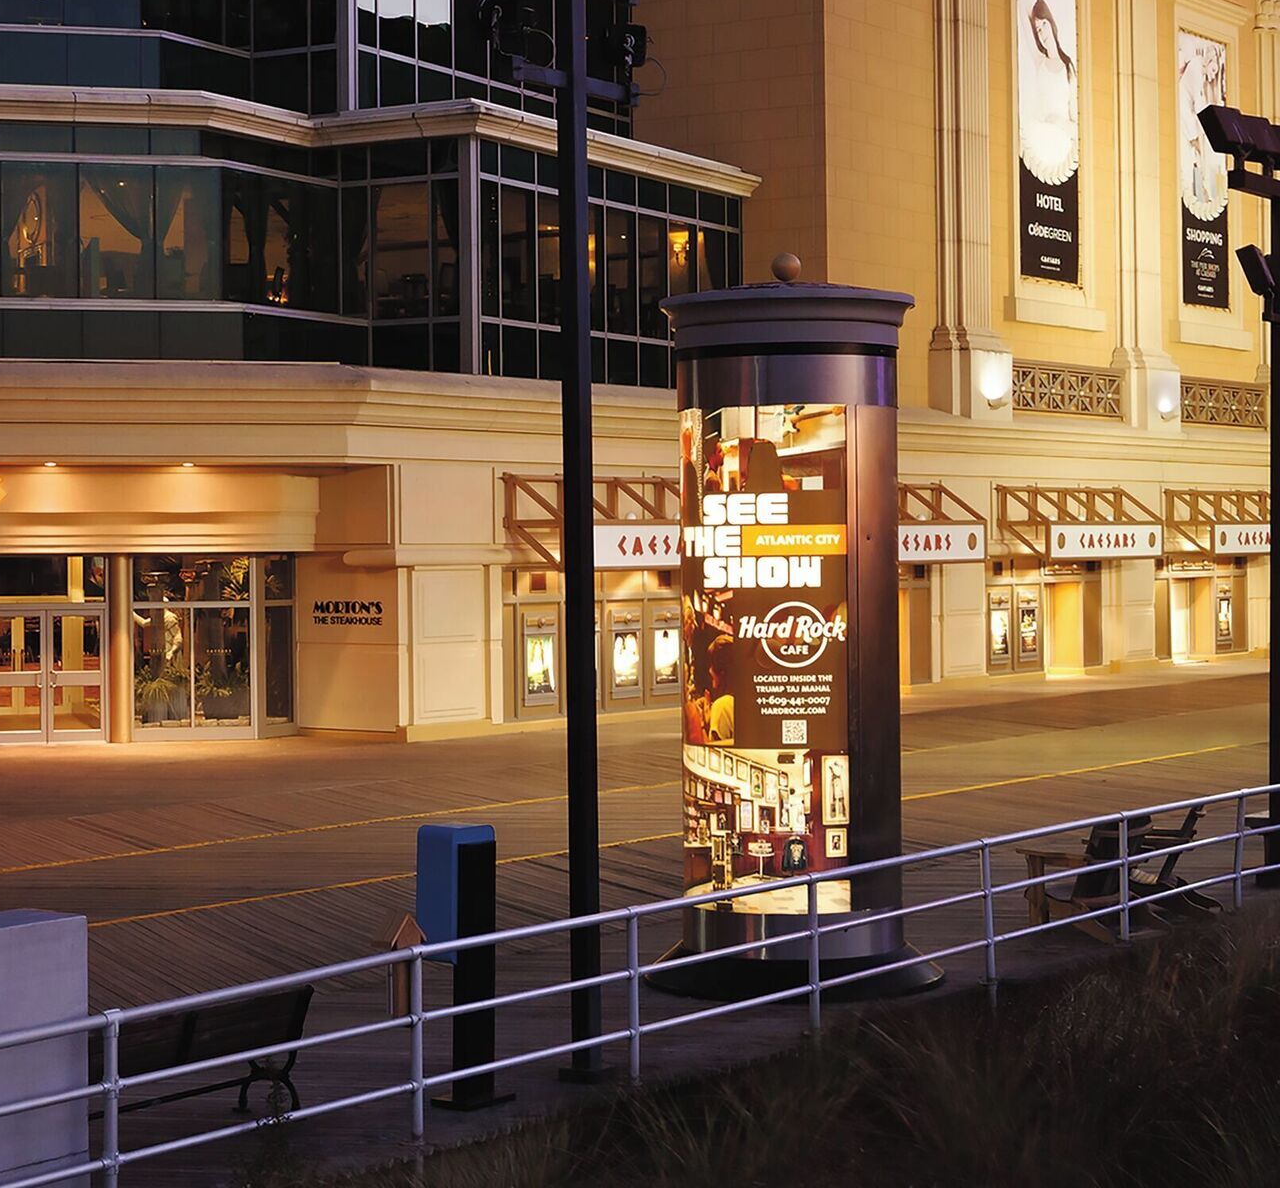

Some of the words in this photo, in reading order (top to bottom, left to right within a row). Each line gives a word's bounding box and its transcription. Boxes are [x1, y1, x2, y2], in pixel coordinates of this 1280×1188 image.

[1035, 193, 1065, 213] HOTEL
[1185, 227, 1223, 246] SHOPPING
[703, 493, 789, 525] SEE
[617, 535, 681, 557] CAES
[684, 525, 741, 557] THE
[755, 534, 814, 546] ATLANTIC
[814, 534, 841, 545] CITY
[901, 532, 952, 552] ESARS
[1080, 532, 1136, 549] CAESARS
[1237, 531, 1271, 546] CAESA
[703, 556, 822, 588] SHOW
[312, 600, 383, 615] MORTON'S
[313, 616, 329, 625] THE
[330, 616, 383, 626] STEAKHOUSE
[738, 615, 795, 639] Hard
[795, 614, 847, 644] Rock
[780, 645, 810, 655] CAFE
[753, 675, 789, 683] LOCATED
[789, 674, 817, 682] INSIDE
[818, 674, 833, 682] THE
[786, 685, 800, 693] TAJ
[801, 684, 831, 692] MAHAL
[760, 707, 827, 715] HARDROCK.COM
